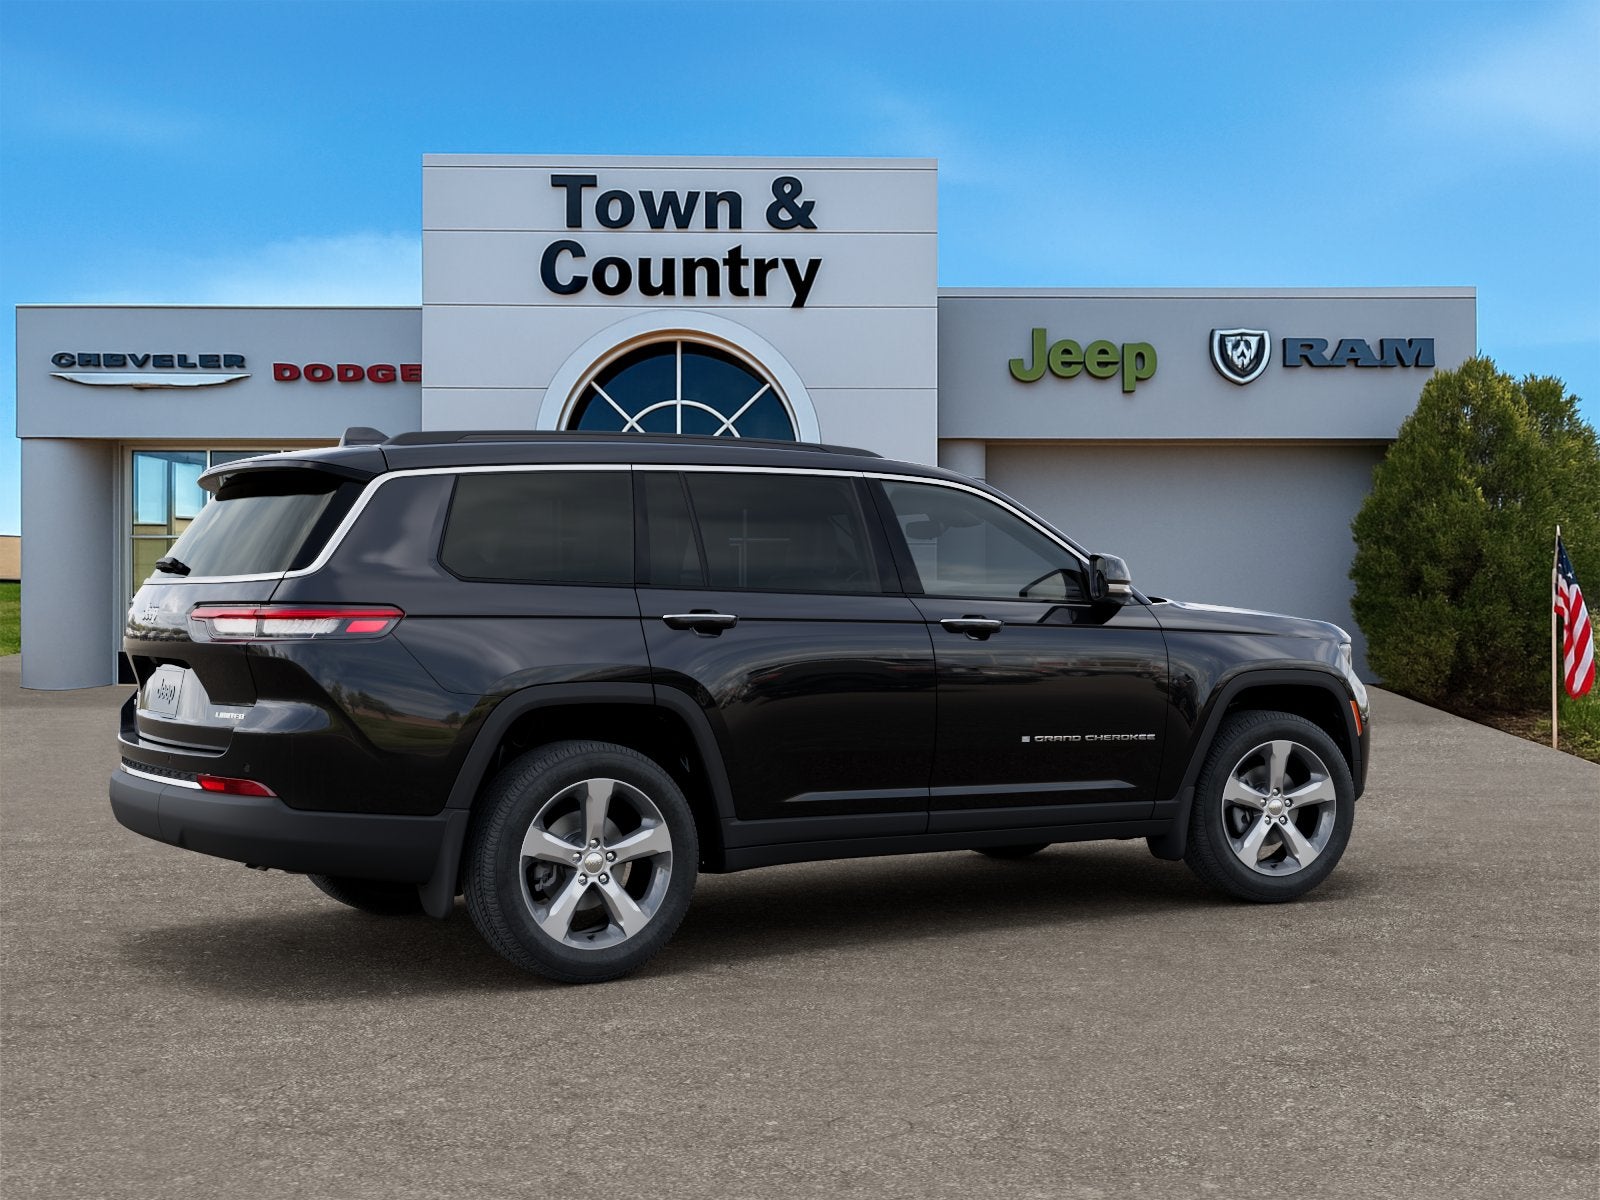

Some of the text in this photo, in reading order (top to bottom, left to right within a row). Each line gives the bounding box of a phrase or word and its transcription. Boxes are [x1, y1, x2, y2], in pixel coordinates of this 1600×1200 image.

[550, 174, 818, 229] Town &
[540, 239, 822, 308] Country
[273, 362, 422, 383] DODGE
[1009, 328, 1157, 393] Jeep
[1283, 338, 1435, 367] RAM
[1085, 733, 1156, 741] CHEROKEE
